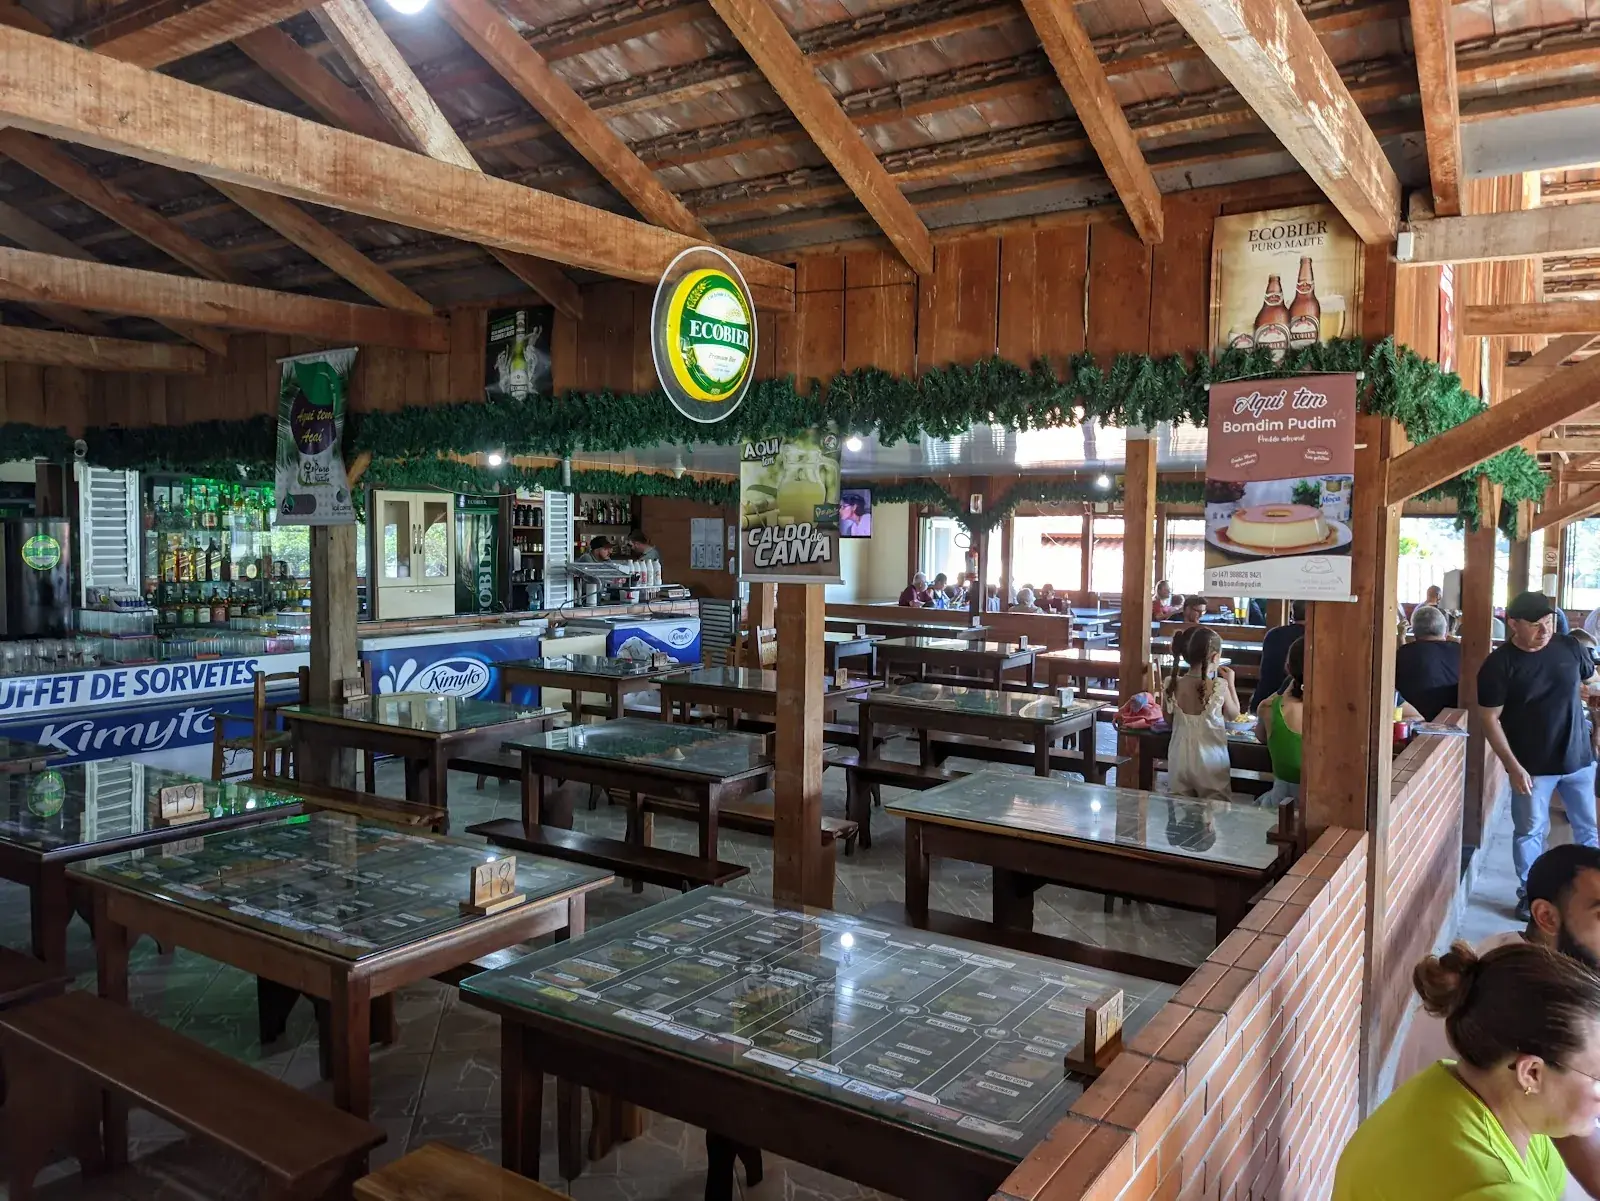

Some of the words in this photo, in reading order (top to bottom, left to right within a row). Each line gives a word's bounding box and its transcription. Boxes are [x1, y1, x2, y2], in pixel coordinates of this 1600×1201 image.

[1248, 220, 1328, 242] ECOBIER
[1251, 241, 1282, 252] PURO
[1285, 237, 1324, 248] MALTE
[689, 319, 750, 350] ECOBIER
[1233, 389, 1287, 418] Aqui
[296, 408, 315, 426] Aqui
[317, 408, 334, 420] tem
[1223, 419, 1283, 433] Bomdim
[1288, 416, 1336, 430] Pudim
[301, 428, 324, 445] Açaí
[744, 439, 780, 458] AQUI
[761, 456, 774, 467] tem
[749, 522, 812, 546] CALDO
[810, 530, 824, 543] de
[754, 537, 831, 568] CANA
[90, 671, 128, 701] DE
[134, 659, 259, 695] SORVETES
[424, 666, 482, 692] Kimyto
[165, 785, 196, 813] 49
[478, 861, 512, 899] 48
